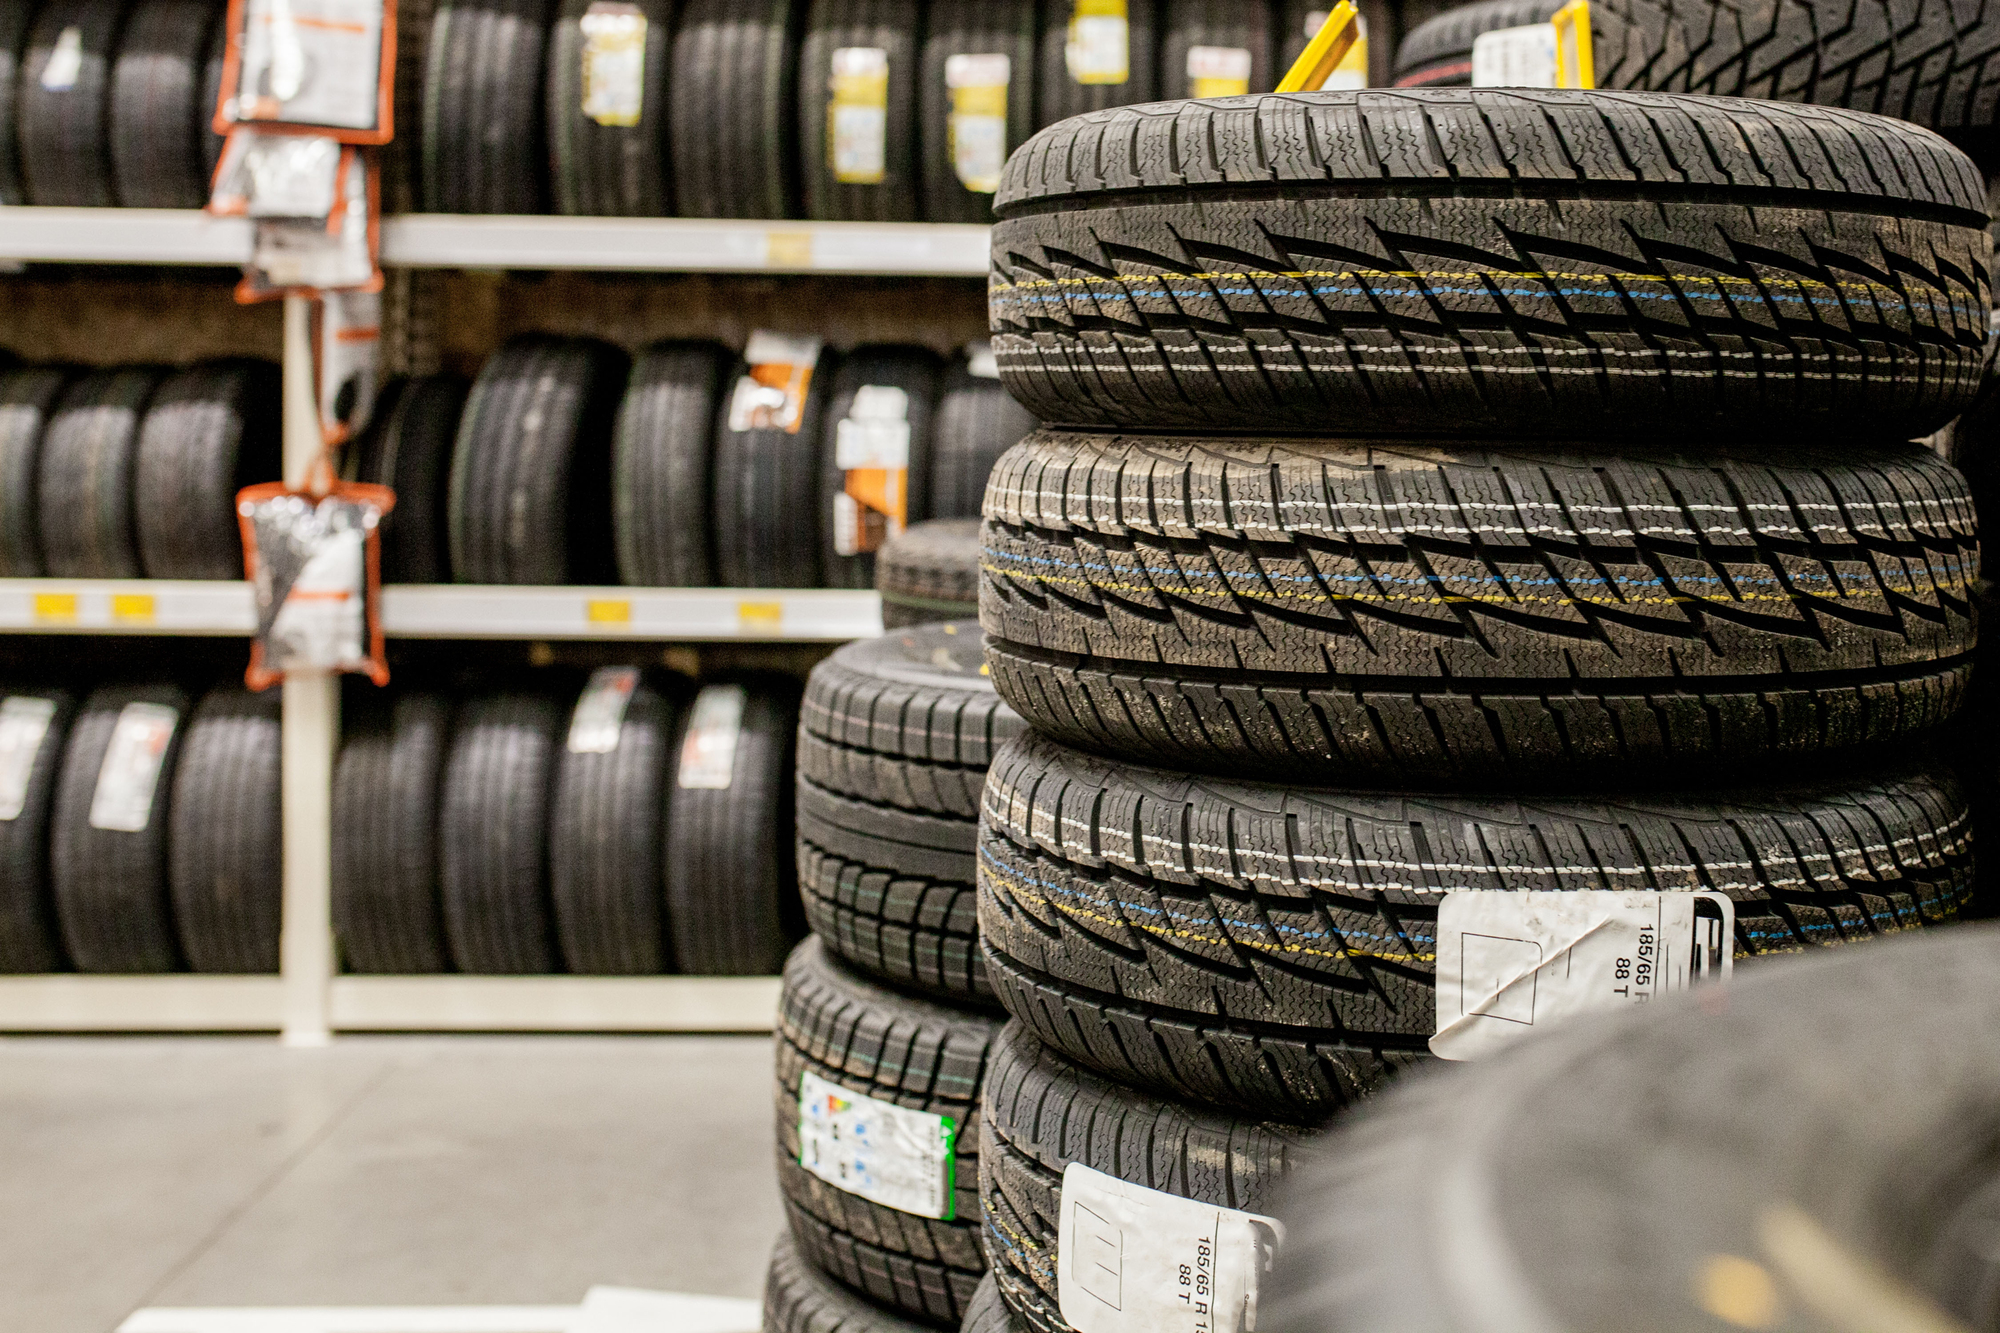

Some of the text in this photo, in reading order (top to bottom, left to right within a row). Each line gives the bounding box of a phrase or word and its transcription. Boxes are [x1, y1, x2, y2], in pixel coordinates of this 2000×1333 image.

[1613, 957, 1631, 998] 88 T
[1634, 924, 1654, 1005] 185/65 R
[1178, 1263, 1192, 1304] 88 T
[1196, 1236, 1211, 1296] 185/65
[1195, 1301, 1208, 1315] R
